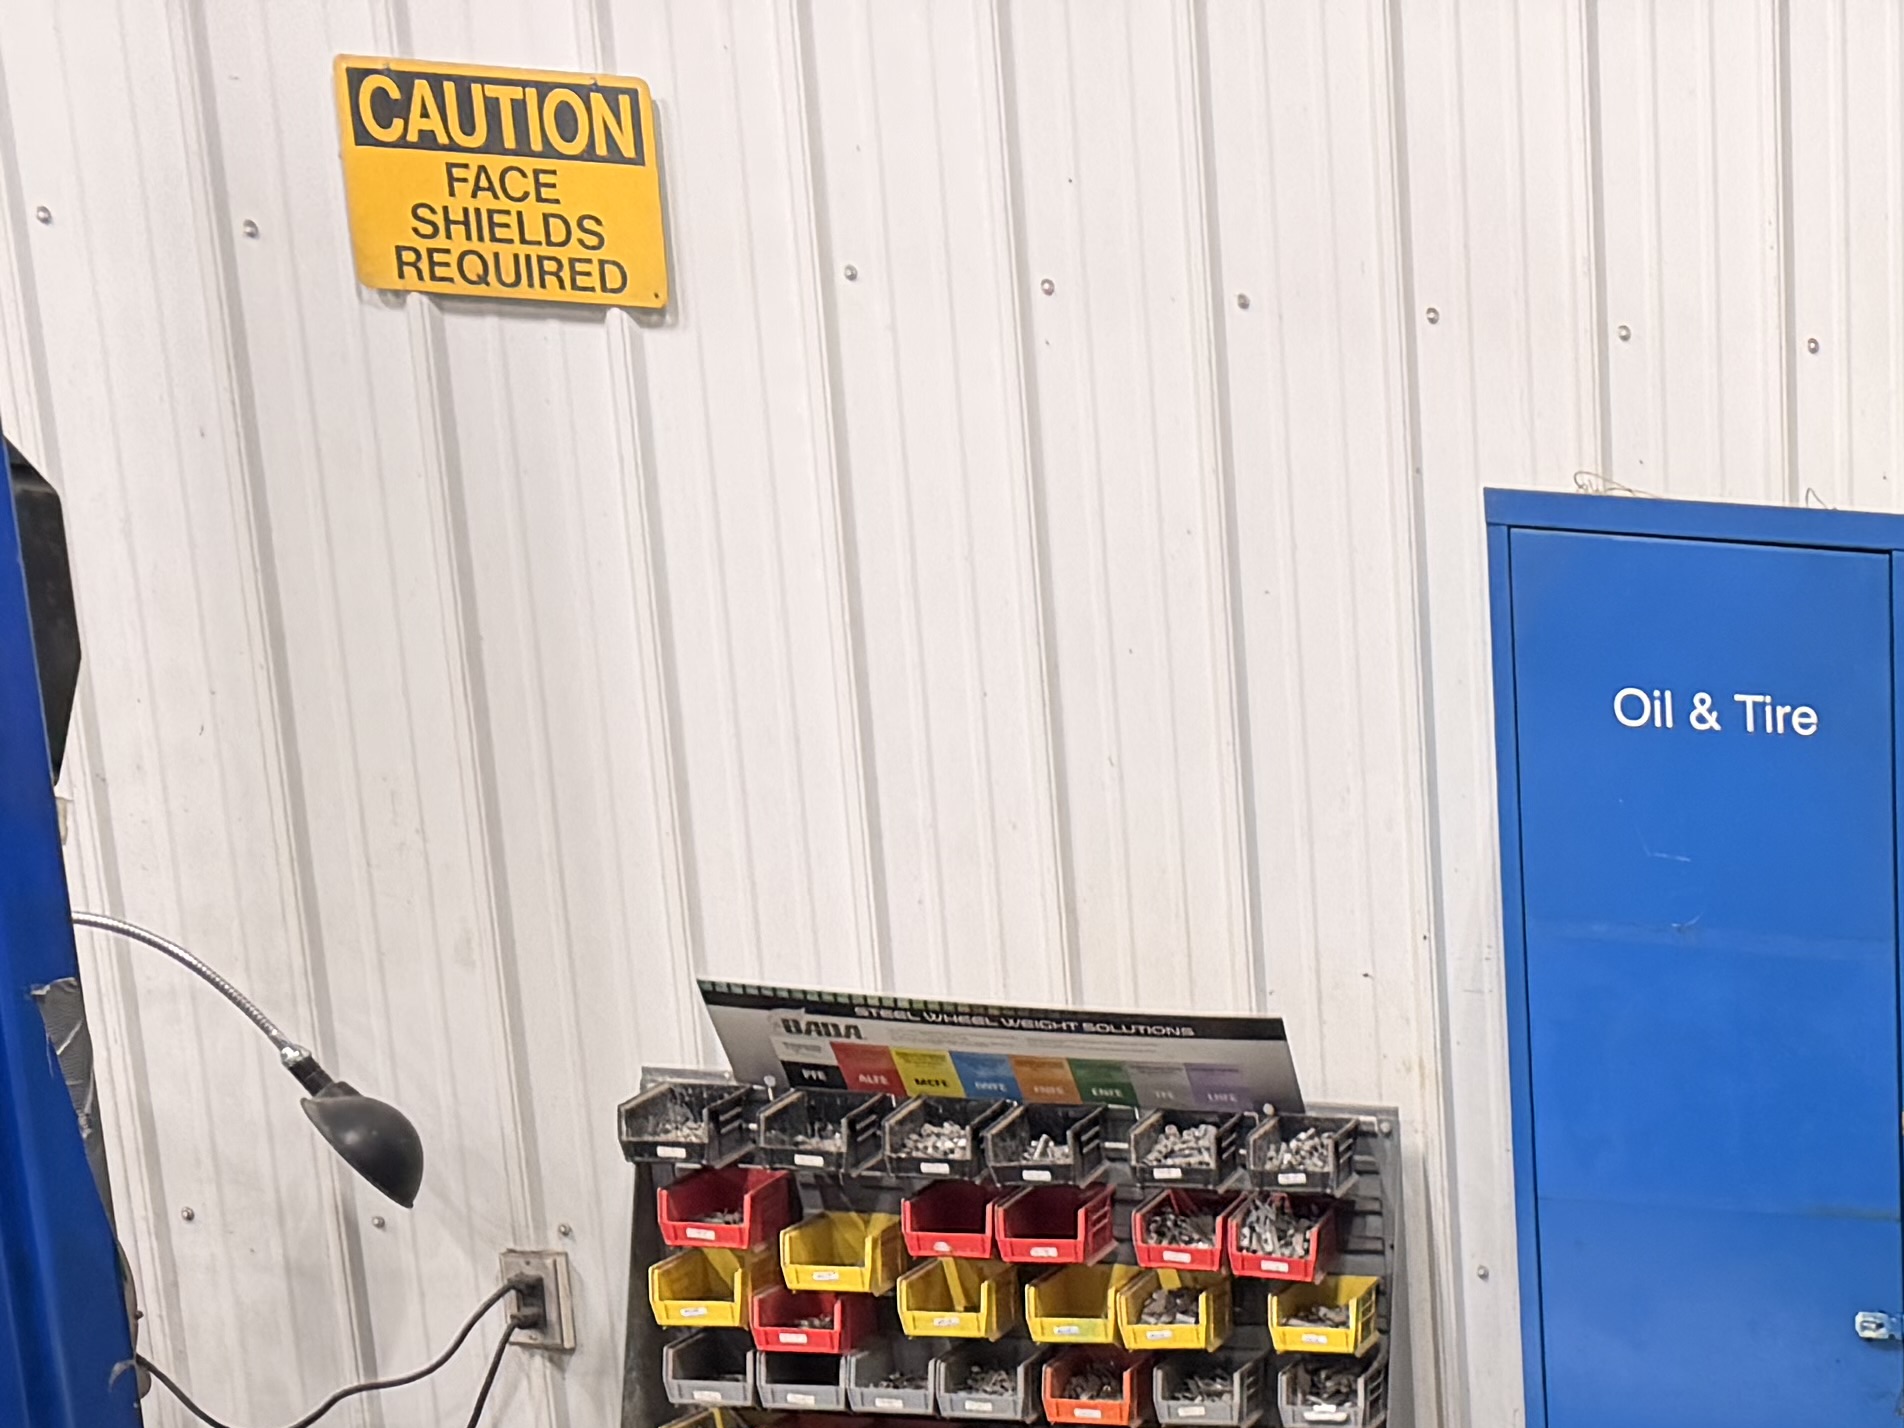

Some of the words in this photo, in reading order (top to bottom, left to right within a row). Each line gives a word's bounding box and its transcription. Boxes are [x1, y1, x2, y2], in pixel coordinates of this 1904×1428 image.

[358, 74, 637, 158] CAUTION
[446, 162, 561, 204] FACE
[411, 203, 605, 251] SHIELDS
[395, 245, 628, 293] REQUIRED
[1613, 687, 1673, 728] Oil
[1689, 691, 1721, 731] &
[1733, 694, 1818, 735] Tire
[854, 1006, 921, 1021] STEEL
[923, 1012, 999, 1026] WHEEL
[1000, 1018, 1078, 1032] WEIGHT
[1081, 1022, 1195, 1037] SOLUTIONS
